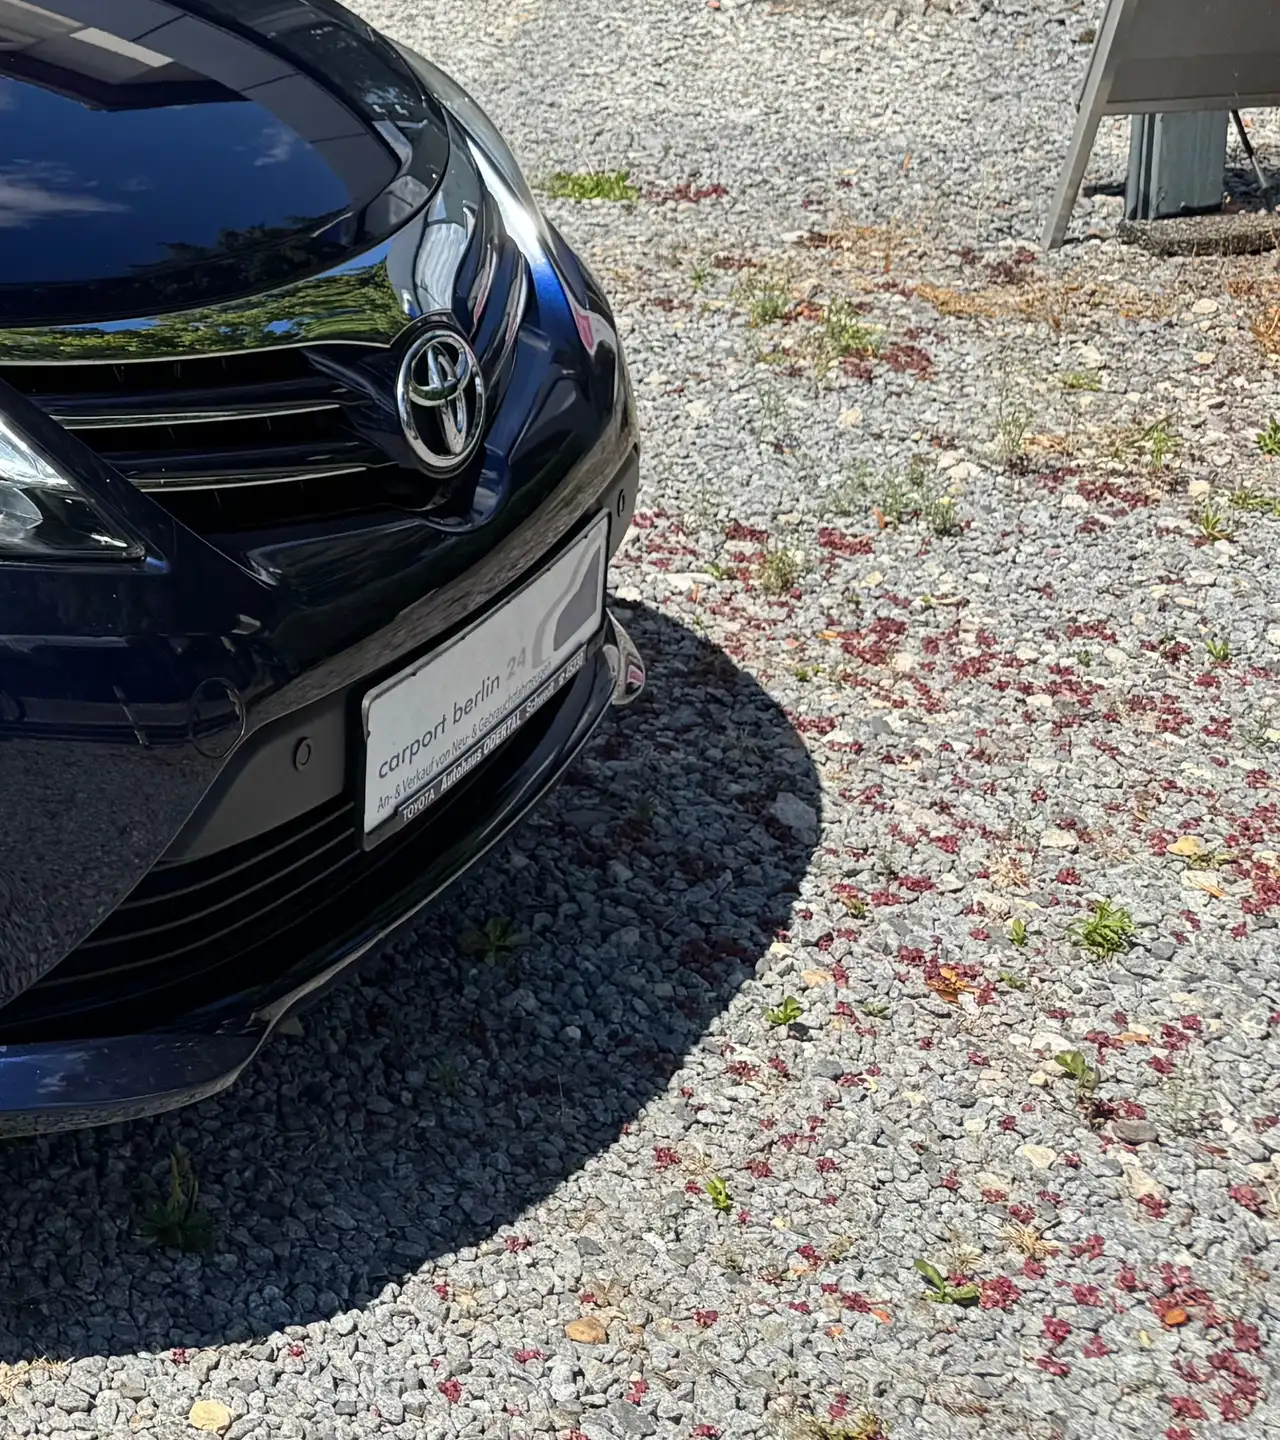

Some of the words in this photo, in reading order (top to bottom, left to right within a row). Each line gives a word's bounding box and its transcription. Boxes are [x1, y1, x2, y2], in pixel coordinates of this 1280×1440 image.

[378, 713, 447, 779] carport
[453, 675, 500, 725] berlin
[506, 646, 526, 680] 24
[402, 787, 436, 822] TOYOTA
[440, 747, 483, 792] Autohaus
[483, 711, 521, 755] ODERTAL
[402, 755, 435, 793] Verkauf
[434, 748, 452, 768] von
